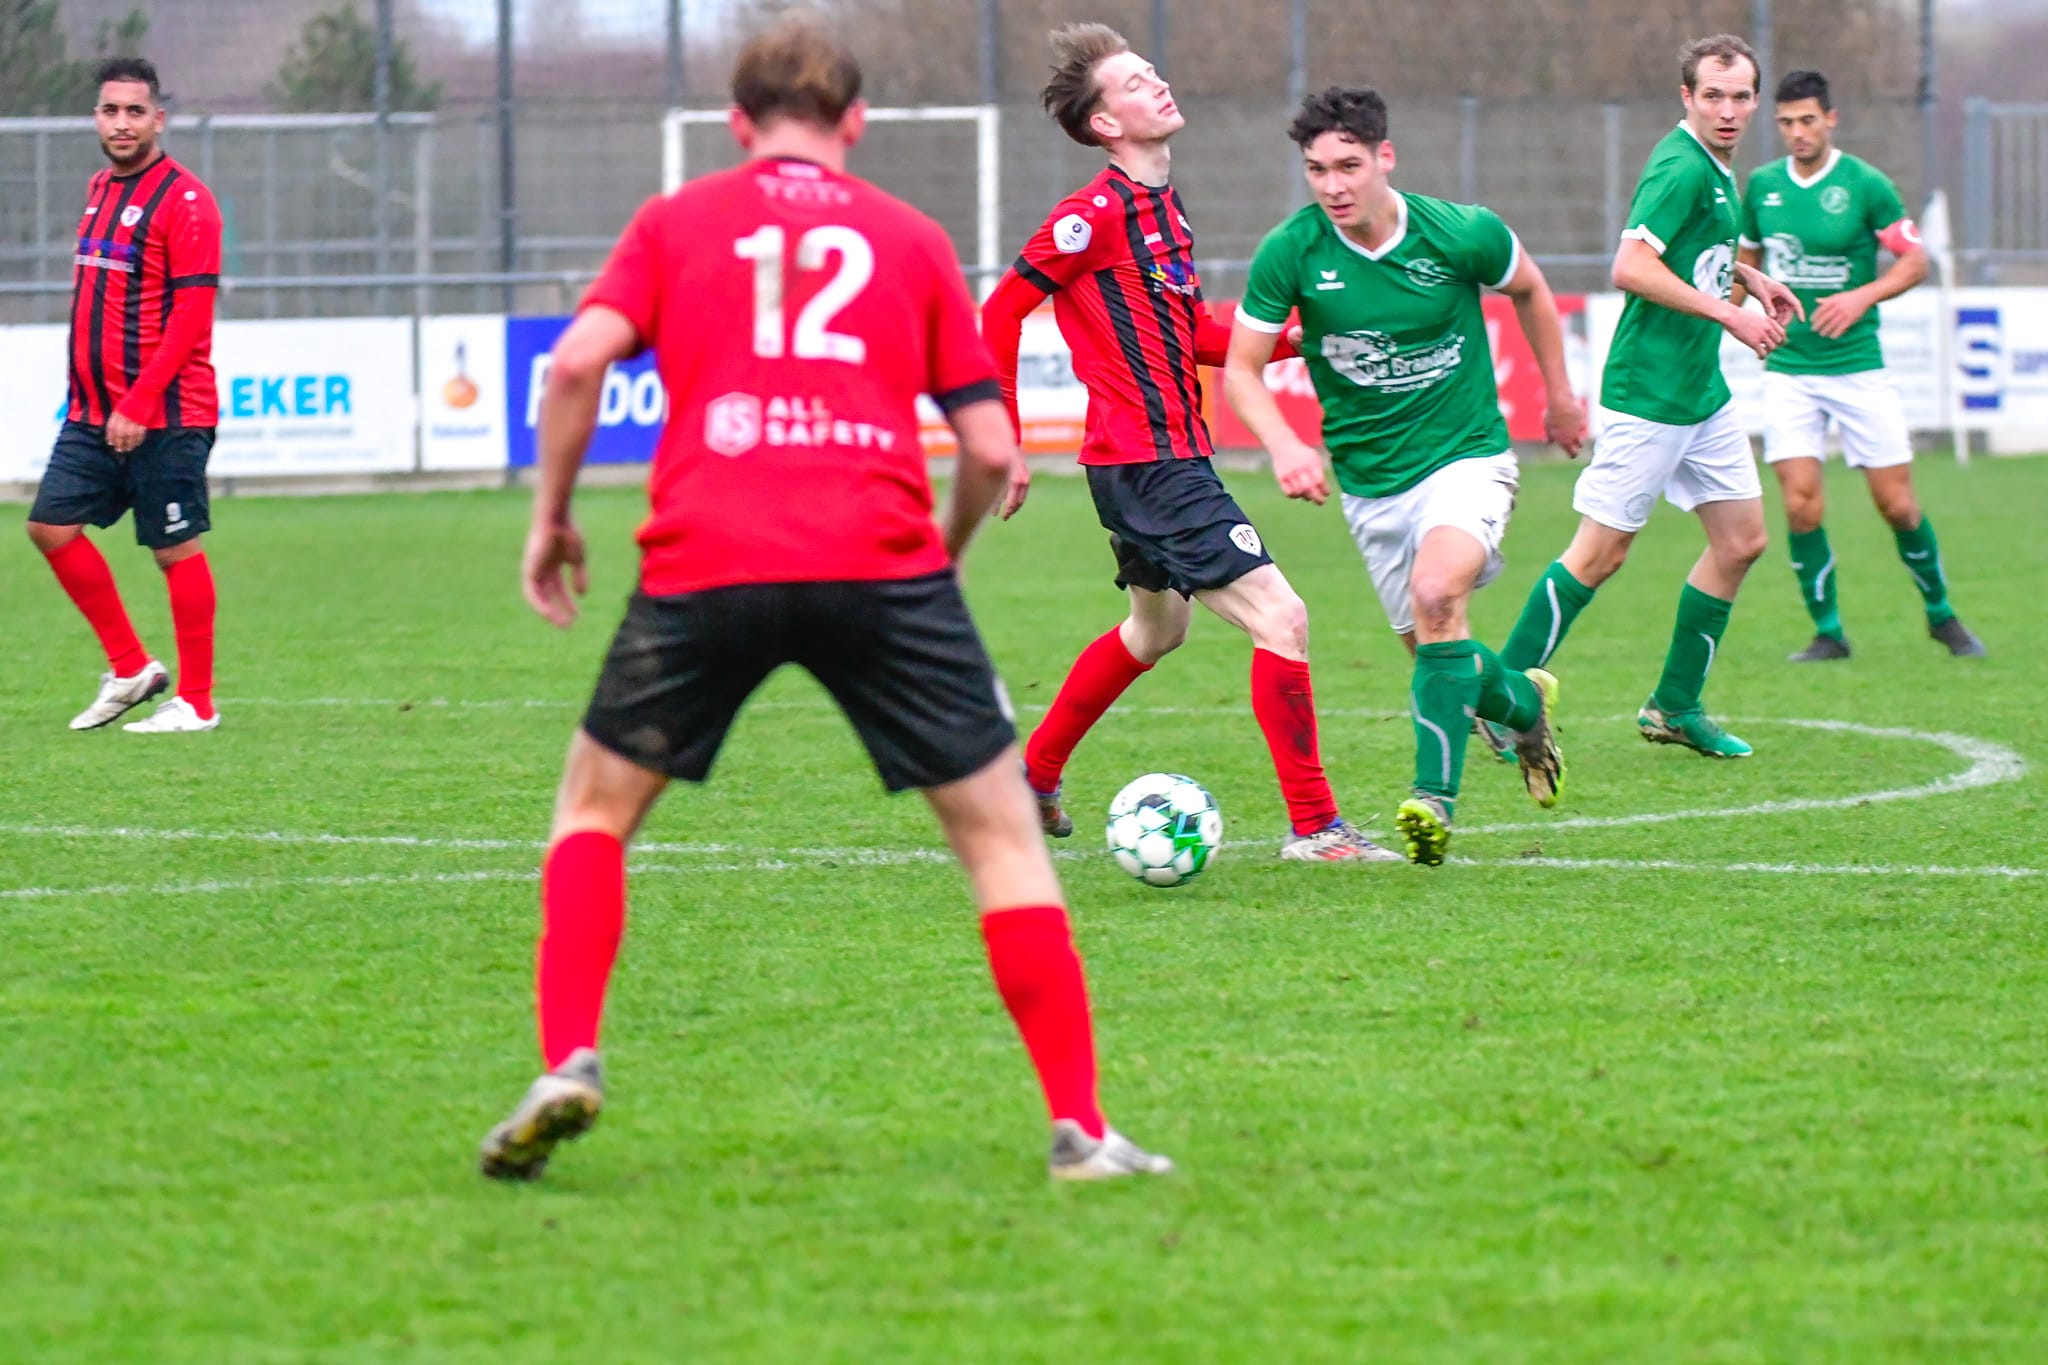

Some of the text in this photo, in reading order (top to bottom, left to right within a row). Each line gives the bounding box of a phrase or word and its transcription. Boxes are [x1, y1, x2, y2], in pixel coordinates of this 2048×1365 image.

[733, 225, 875, 365] 12
[766, 395, 832, 423] ALL
[766, 419, 895, 451] SAFETY
